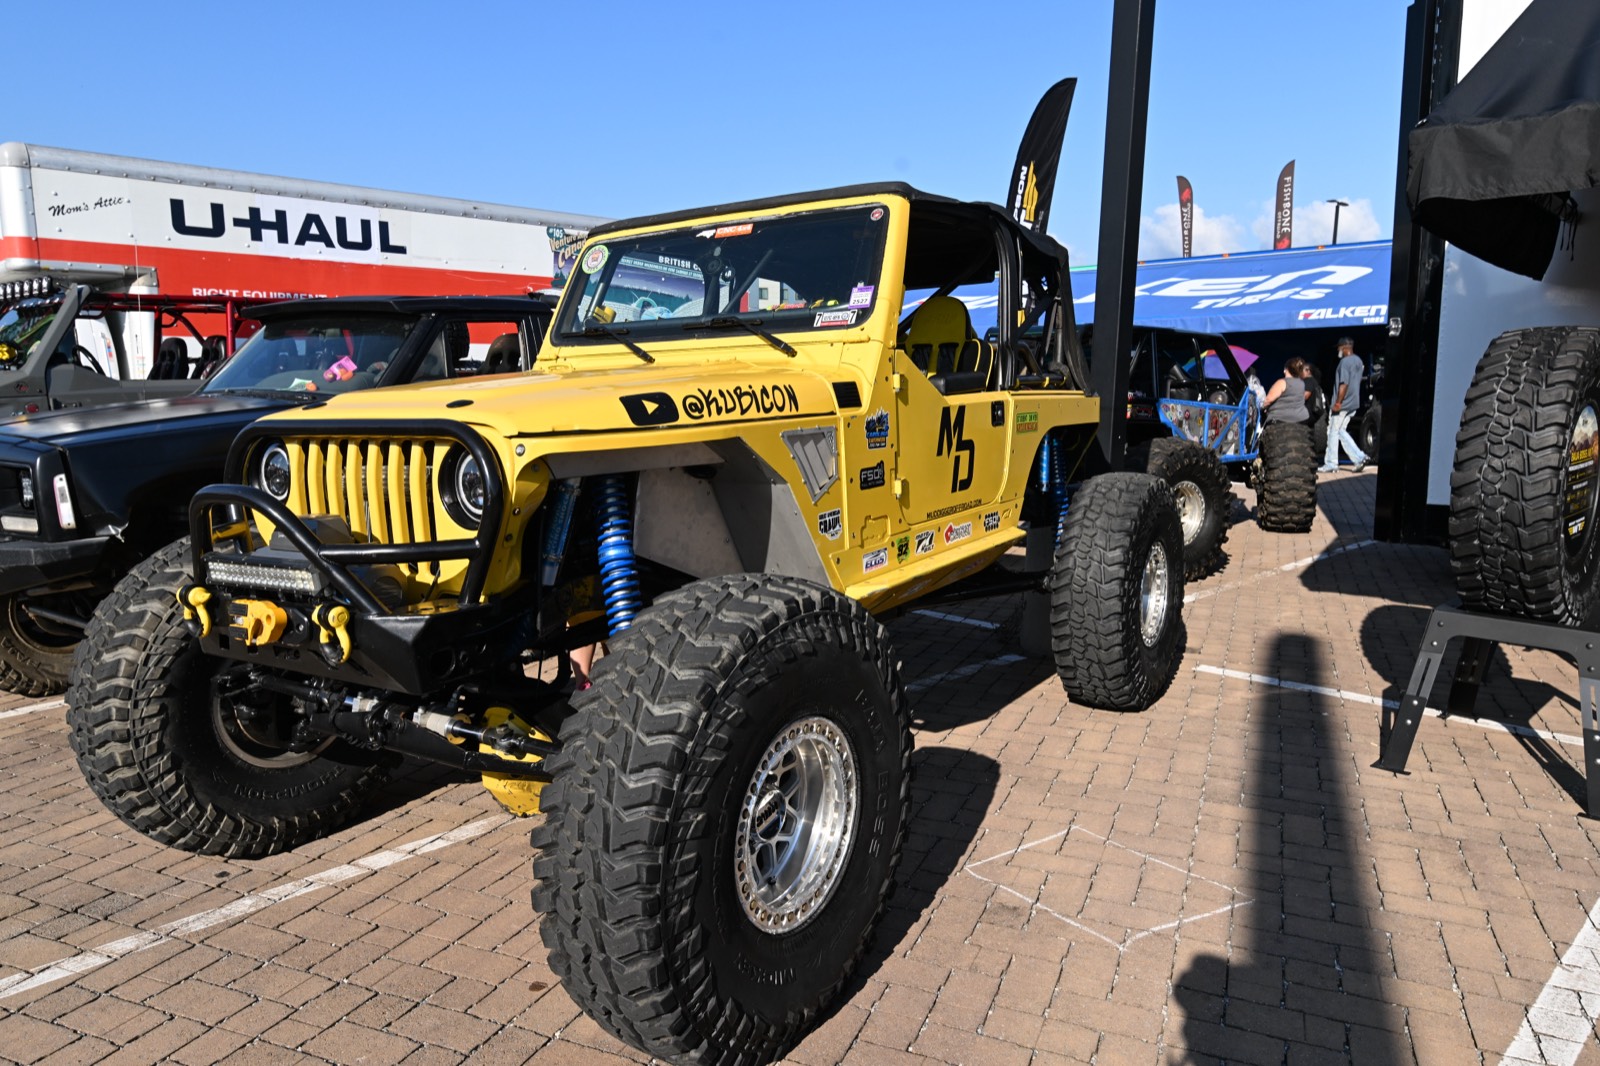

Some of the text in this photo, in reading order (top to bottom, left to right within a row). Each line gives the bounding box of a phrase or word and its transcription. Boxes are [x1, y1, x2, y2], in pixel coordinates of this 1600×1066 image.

[48, 196, 124, 217] Mom's Attic
[1281, 176, 1292, 233] FISHBONE
[169, 198, 408, 255] U-HAUL
[558, 238, 588, 269] Canad
[658, 255, 691, 269] BRITISH
[242, 289, 328, 299] EQUIP
[1190, 287, 1334, 310] TIRES
[1298, 304, 1388, 320] FALKEN
[1363, 316, 1386, 324] TIRES
[897, 543, 909, 556] 92
